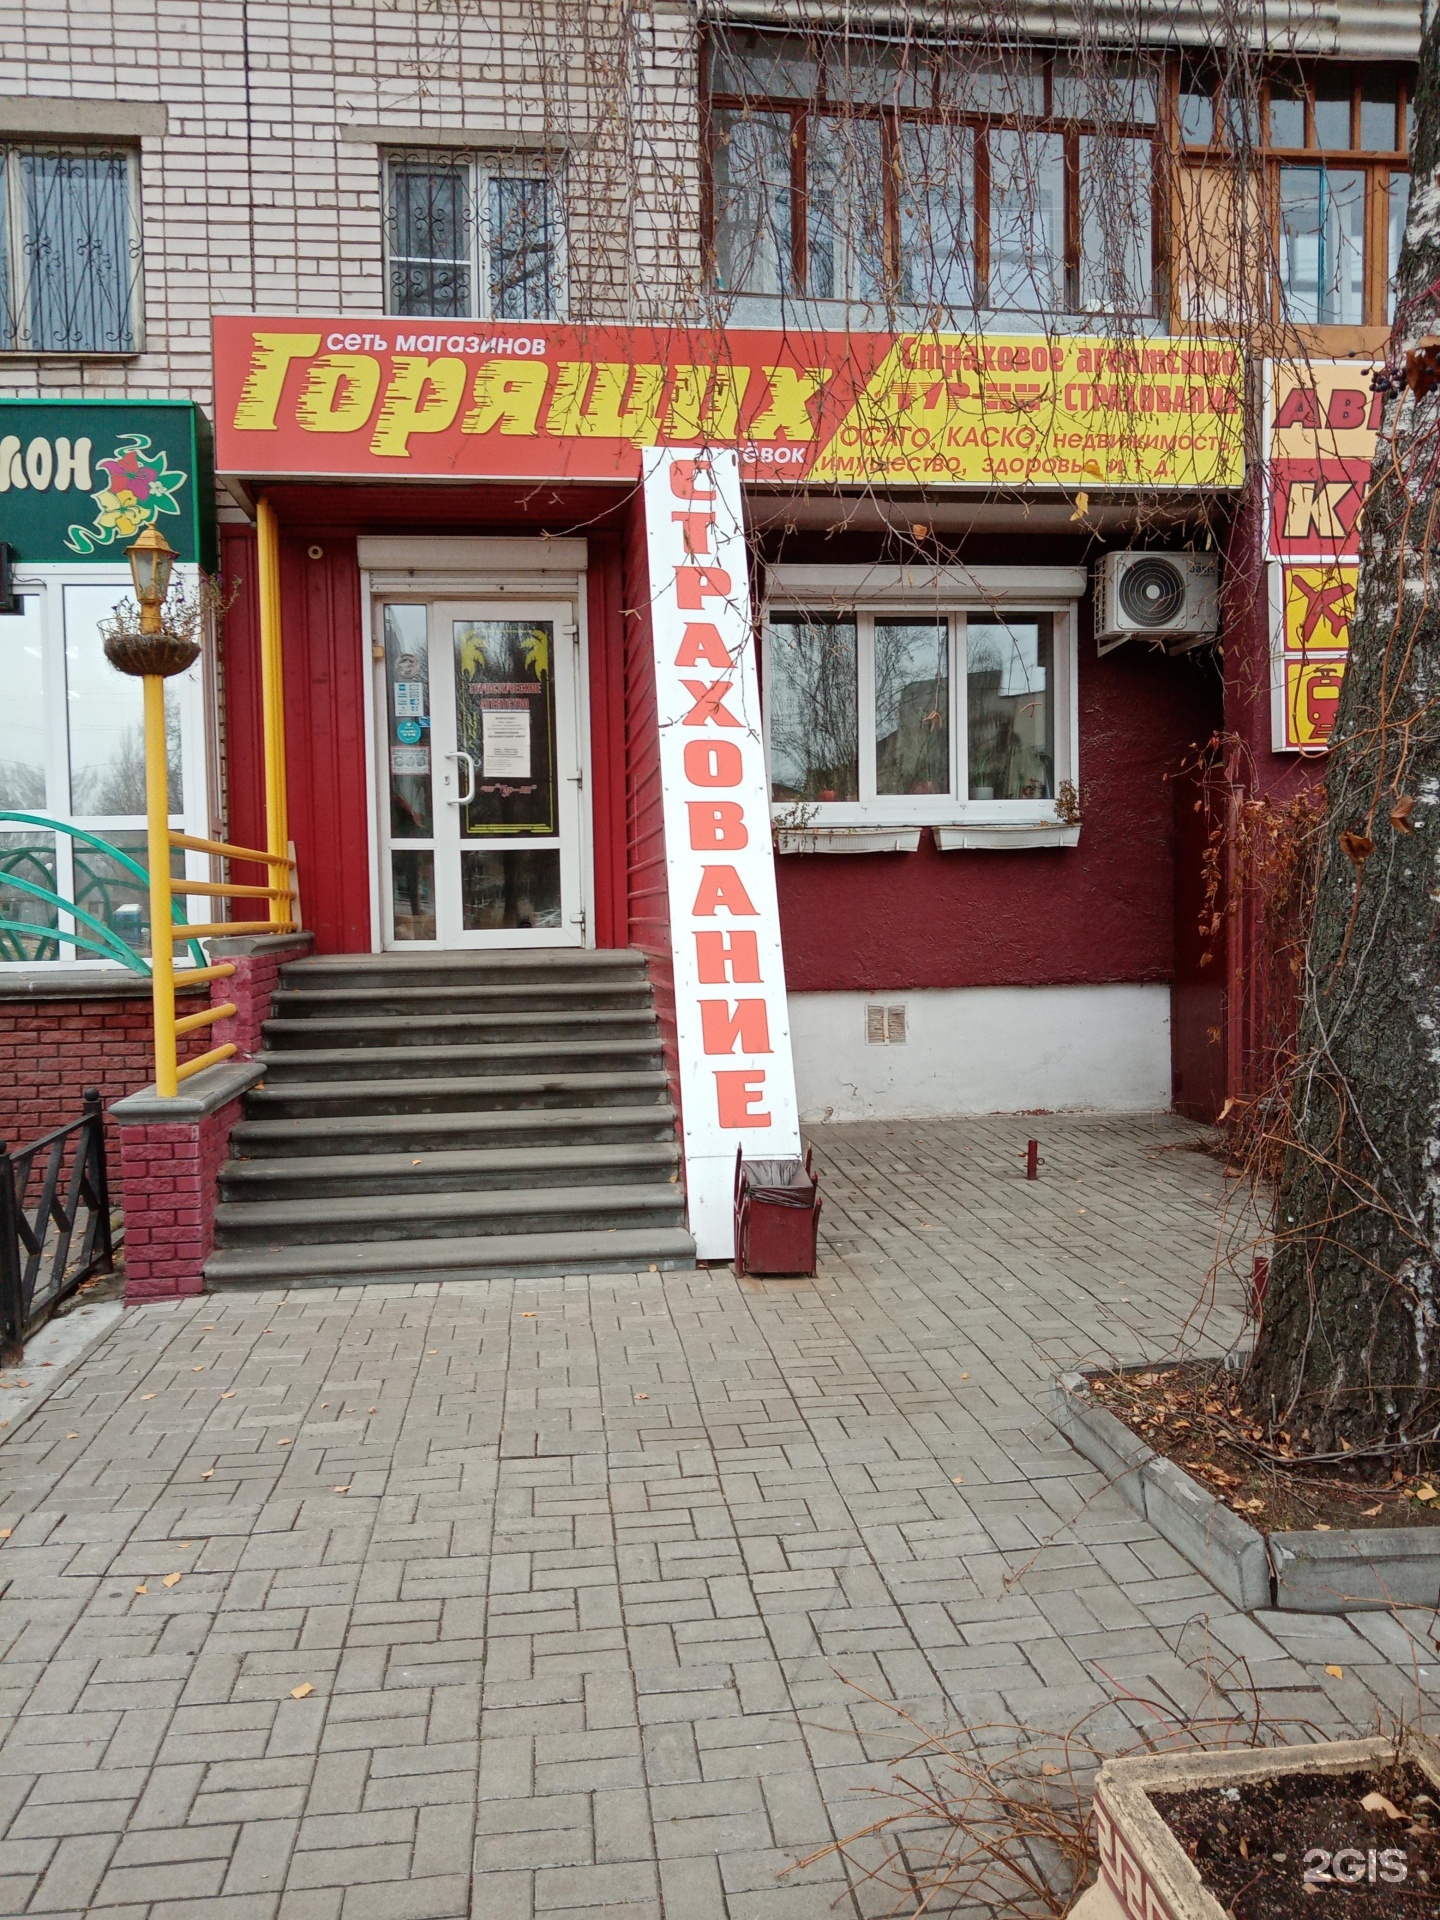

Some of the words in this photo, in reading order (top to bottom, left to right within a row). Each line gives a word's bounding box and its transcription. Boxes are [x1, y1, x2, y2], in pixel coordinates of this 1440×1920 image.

[327, 333, 388, 351] сеть
[395, 335, 546, 355] магазинов
[902, 337, 1064, 377] Страховое
[233, 332, 833, 457] Горящих
[1064, 383, 1239, 414] СТРАХОВАНИЕ
[946, 426, 1042, 451] КАСКО,
[821, 456, 967, 477] имущество,
[669, 460, 774, 1128] СТРАХОВАНИЕ
